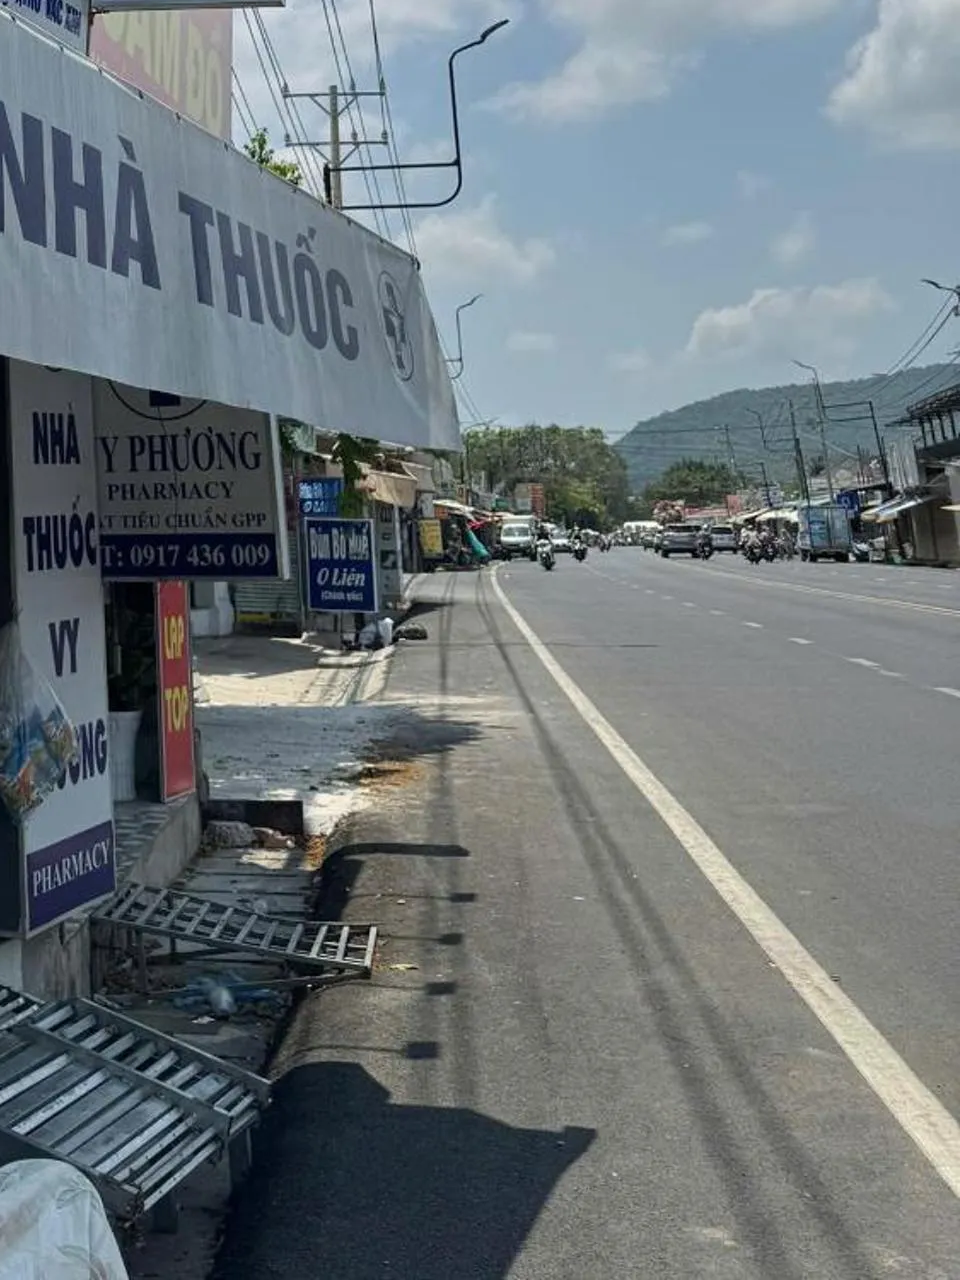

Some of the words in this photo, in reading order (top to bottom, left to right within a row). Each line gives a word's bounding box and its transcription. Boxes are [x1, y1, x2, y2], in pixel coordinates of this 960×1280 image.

[177, 190, 360, 362] THUỐC
[32, 401, 81, 465] NHÀ
[96, 436, 119, 473] Y
[128, 426, 262, 473] PHƯƠNG
[107, 481, 235, 501] PHARMACY
[22, 493, 97, 572] THUỐC
[231, 512, 267, 528] GPP
[102, 544, 123, 567] T:
[129, 543, 181, 567] 0917
[186, 543, 226, 567] 436
[231, 543, 270, 567] 009
[331, 567, 366, 588] Liên
[48, 617, 80, 677] VY
[164, 615, 185, 661] LAP
[164, 686, 189, 733] TOP
[32, 837, 111, 898] PHARMACY
